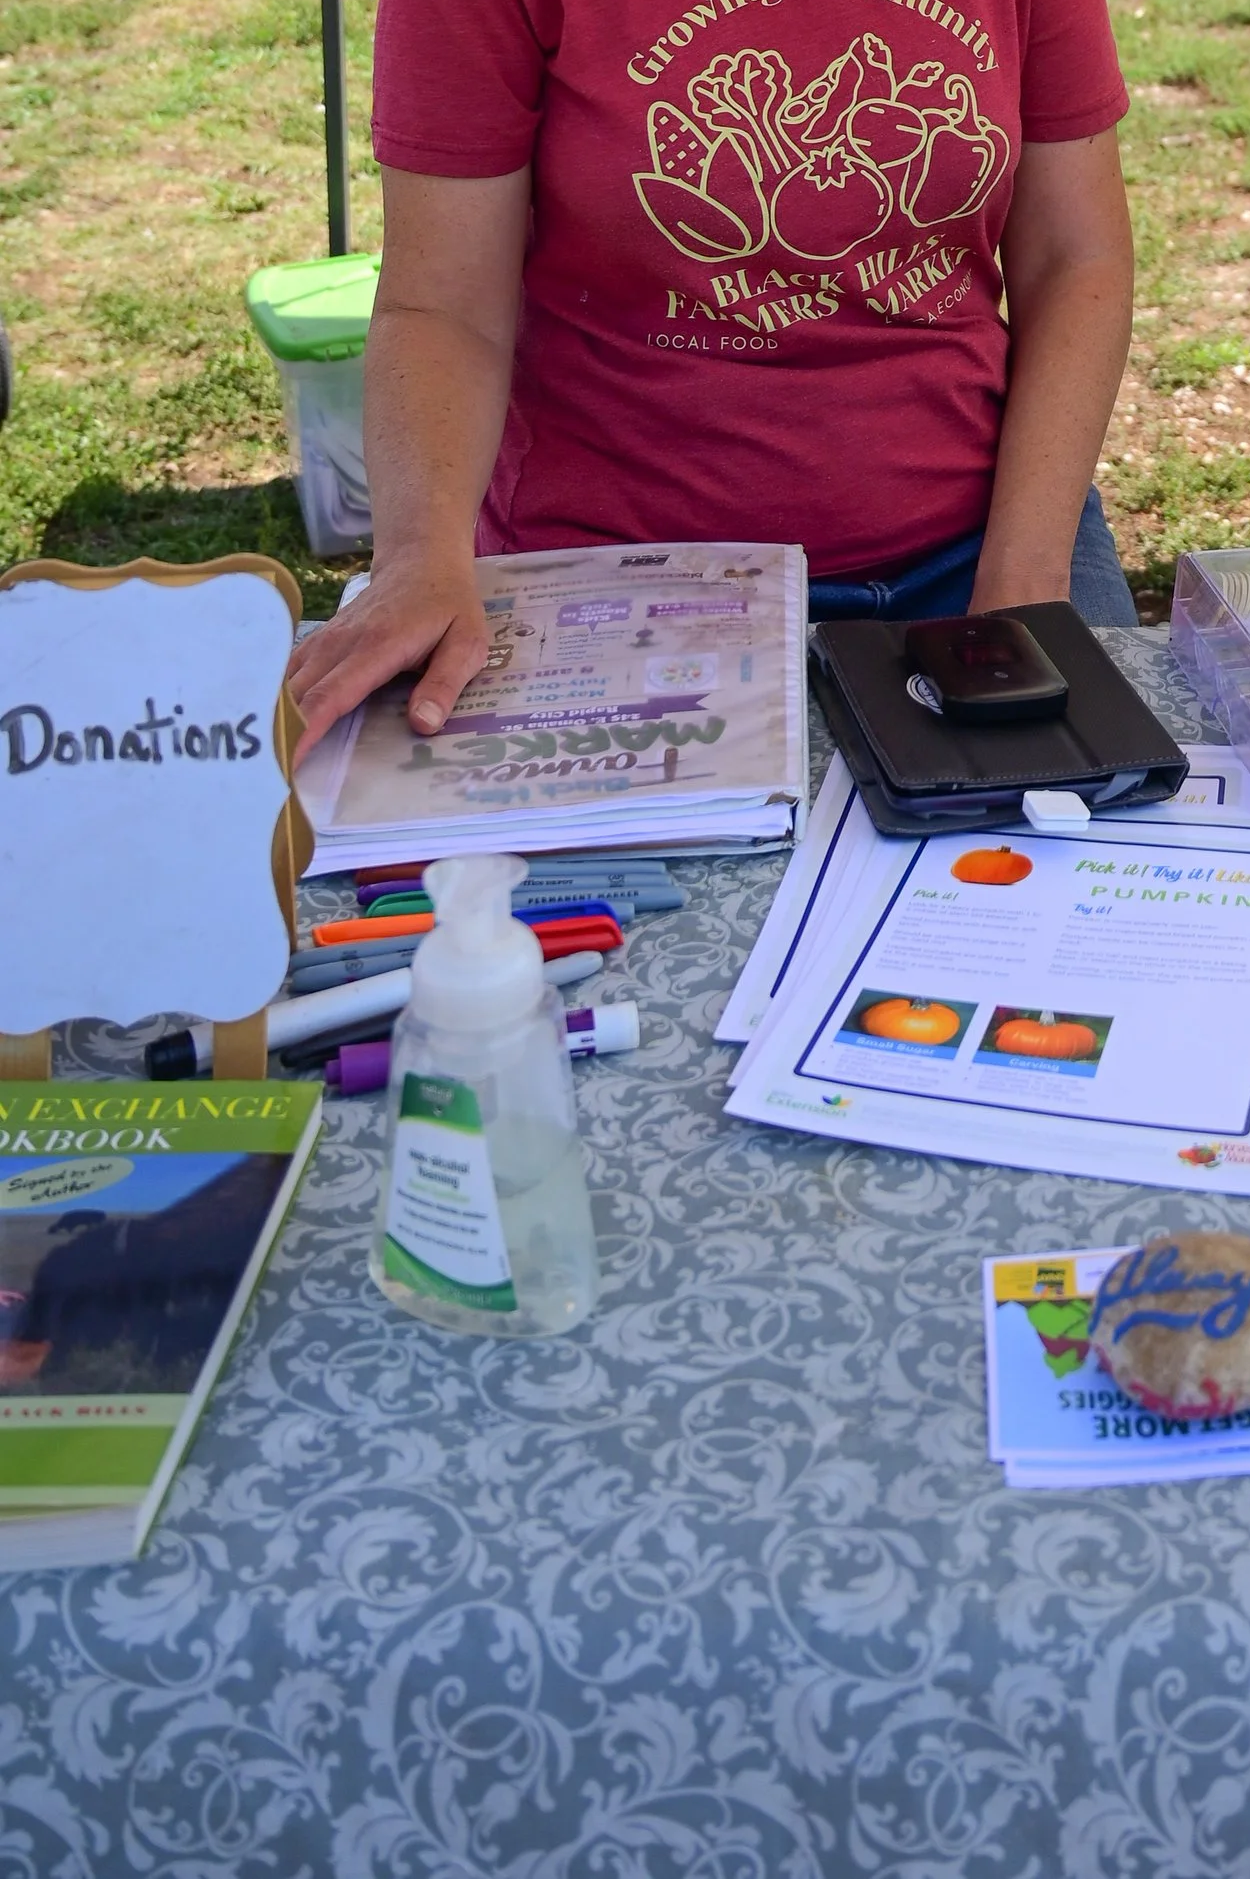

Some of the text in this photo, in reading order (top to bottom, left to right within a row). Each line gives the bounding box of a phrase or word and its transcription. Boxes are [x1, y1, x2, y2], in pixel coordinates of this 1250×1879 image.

[710, 268, 846, 308] BLACK
[666, 289, 841, 333] FAMERS
[648, 334, 778, 350] LOCAL FOOD
[1, 697, 262, 775] Donations
[396, 714, 727, 770] MARKET
[1074, 859, 1118, 876] Pick
[1121, 861, 1148, 878] it!
[1152, 865, 1184, 883] Try
[528, 890, 640, 905] PERMANENT MARKER
[27, 1096, 292, 1121] EXCHANGE
[8, 1167, 73, 1193] Signed
[1093, 1414, 1192, 1440] MORE
